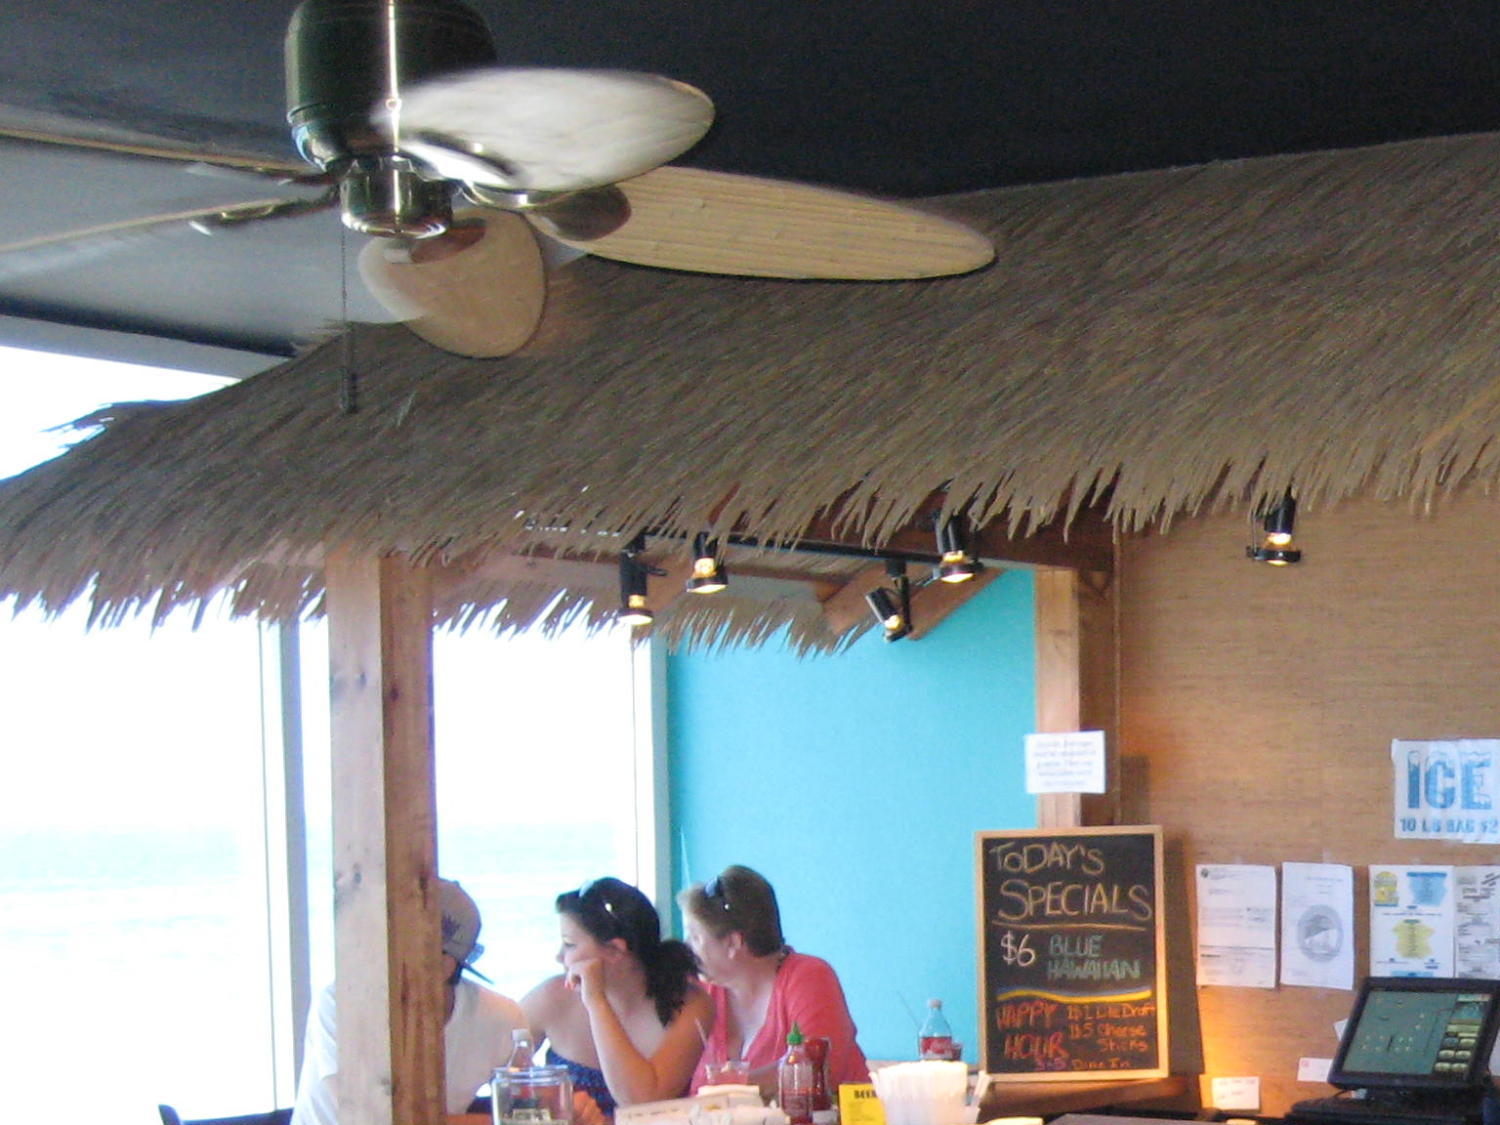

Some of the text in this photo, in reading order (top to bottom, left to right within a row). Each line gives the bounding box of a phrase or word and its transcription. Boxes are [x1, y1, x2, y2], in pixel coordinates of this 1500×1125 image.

[1406, 751, 1493, 810] ICE
[998, 878, 1152, 922] SPECIALS
[1000, 930, 1036, 967] $6
[1049, 933, 1104, 957] BLUE
